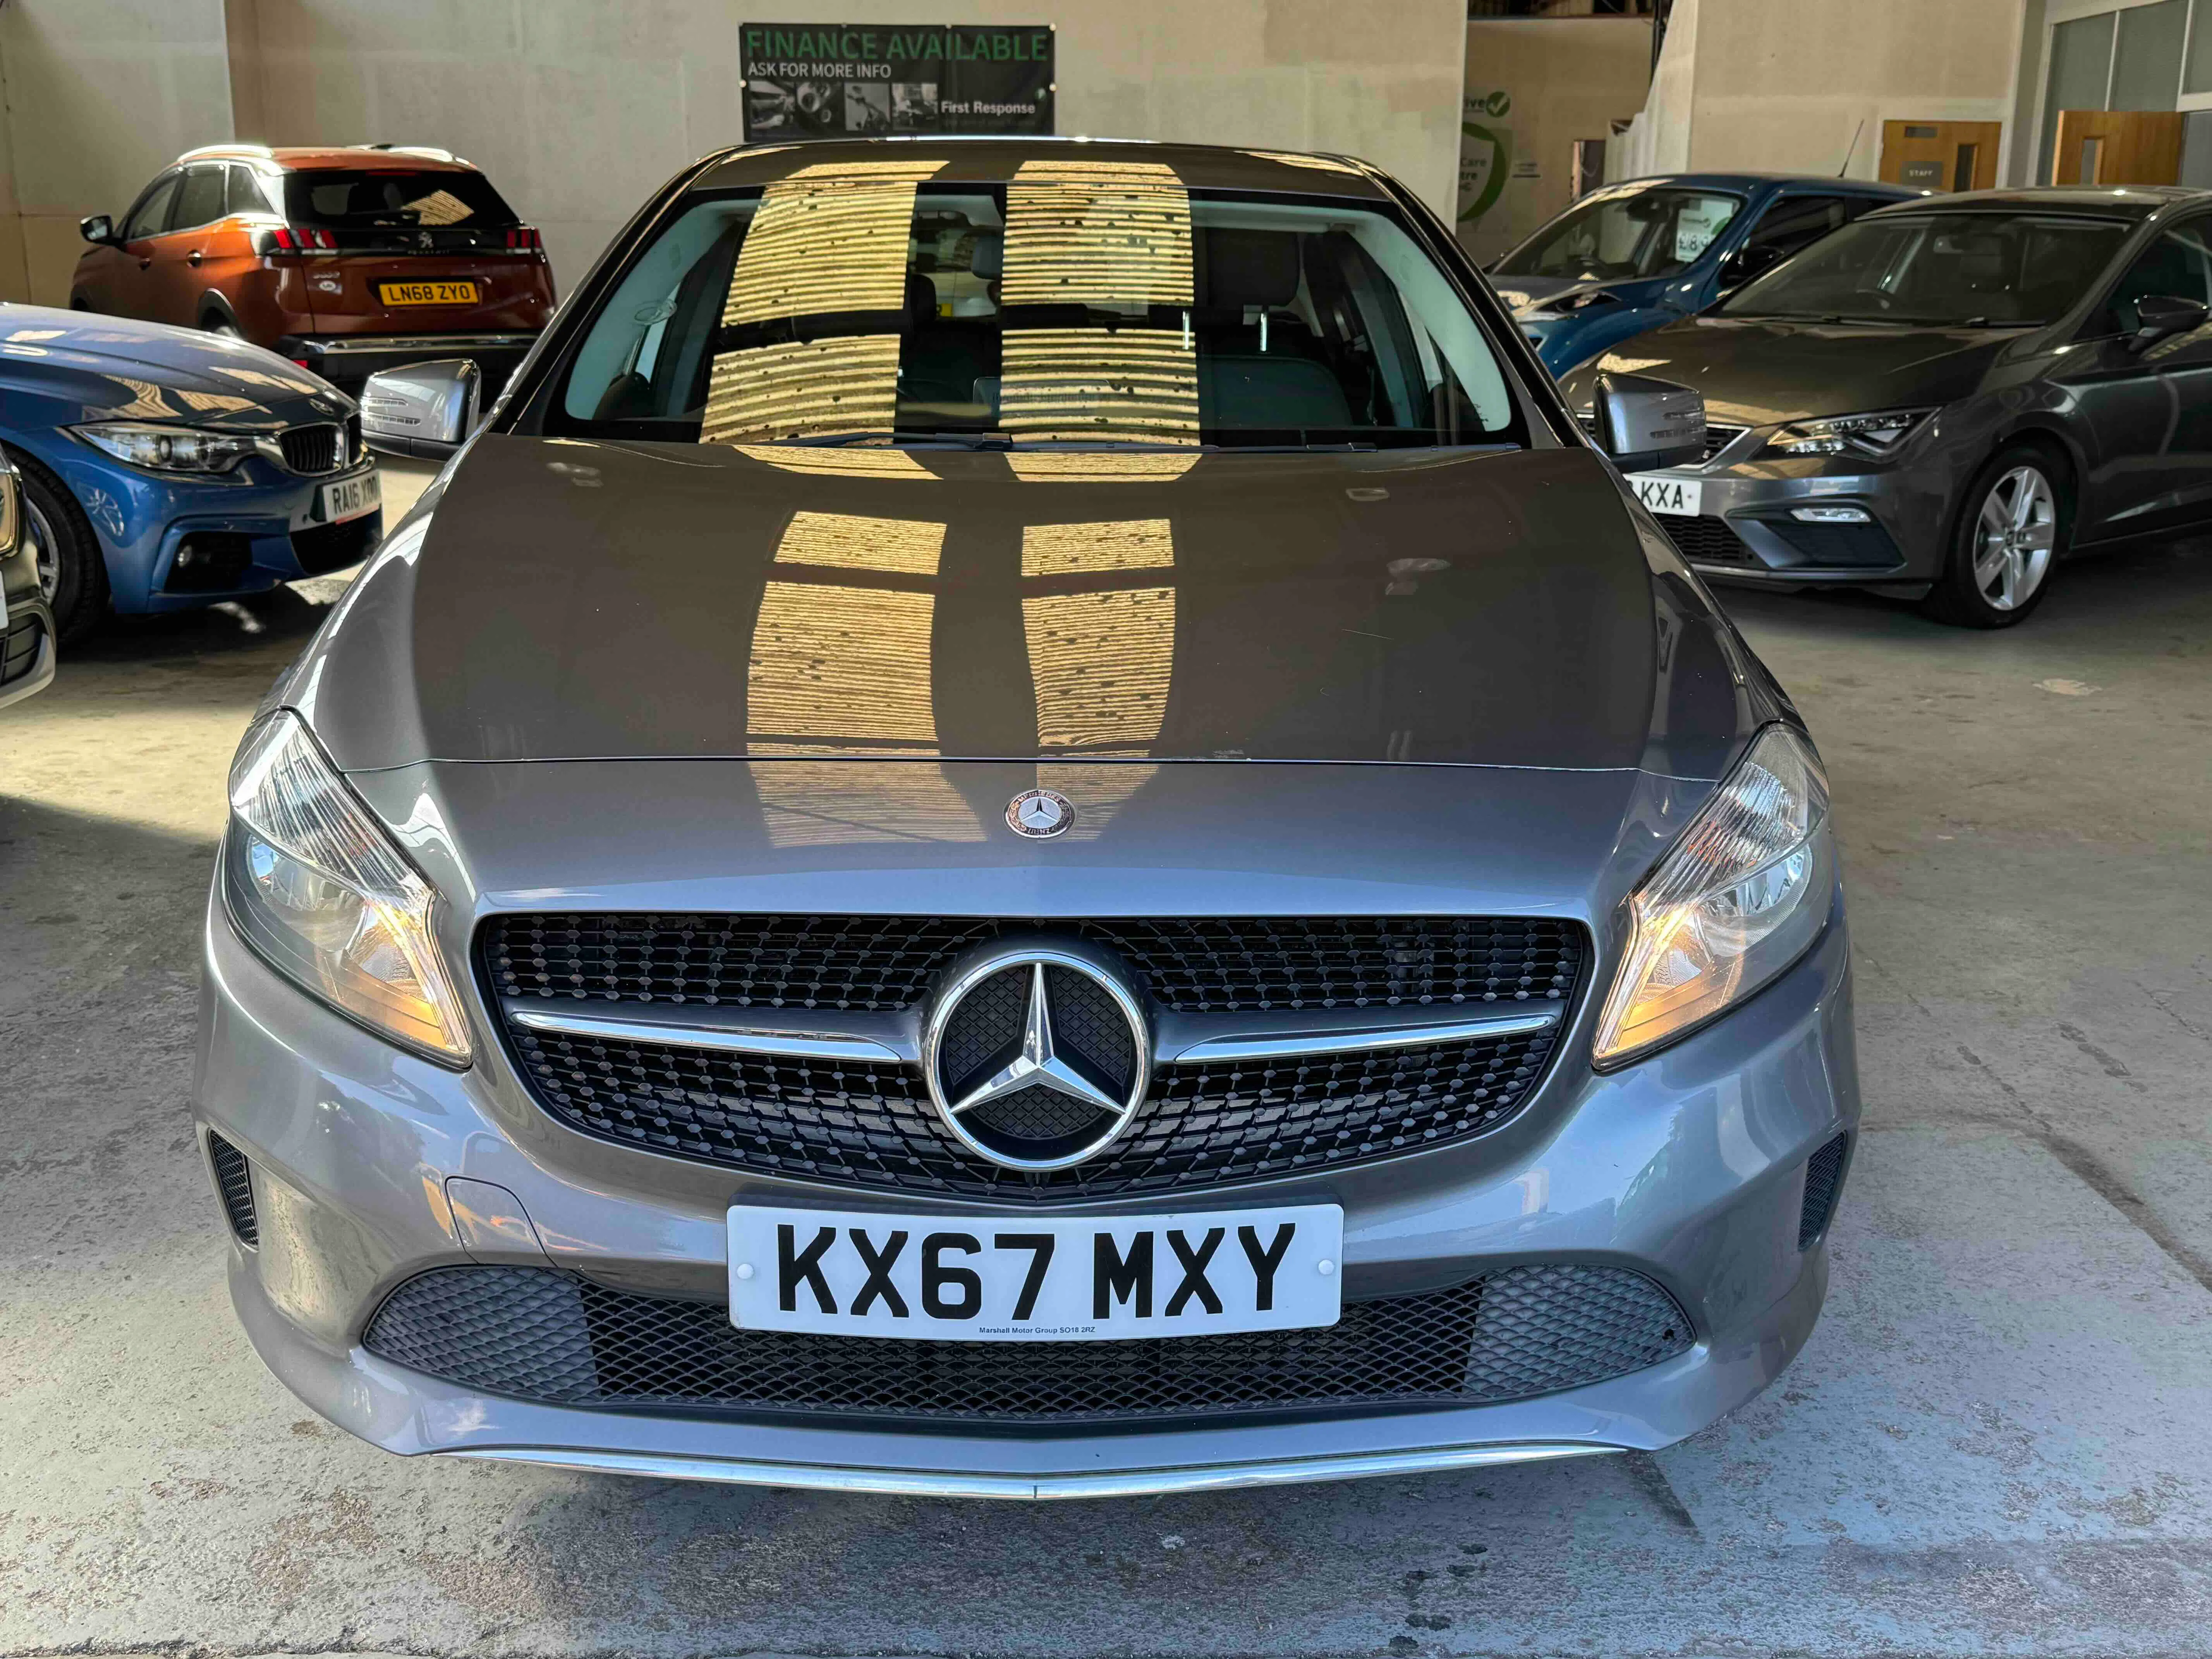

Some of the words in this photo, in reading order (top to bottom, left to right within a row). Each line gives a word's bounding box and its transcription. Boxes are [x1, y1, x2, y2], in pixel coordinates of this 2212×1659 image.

[746, 30, 878, 60] FINANCE
[886, 33, 1048, 61] AVAILABLE
[748, 62, 776, 77] ASK
[780, 63, 809, 77] FOR
[812, 63, 853, 78] MORE
[857, 64, 891, 79] INFO
[941, 100, 970, 114] First
[973, 100, 1036, 117] Response
[388, 285, 434, 302] LN68
[332, 483, 360, 514] RA16
[1641, 481, 1684, 509] KXA
[778, 1223, 1055, 1321] KX67
[1093, 1223, 1297, 1319] MXY
